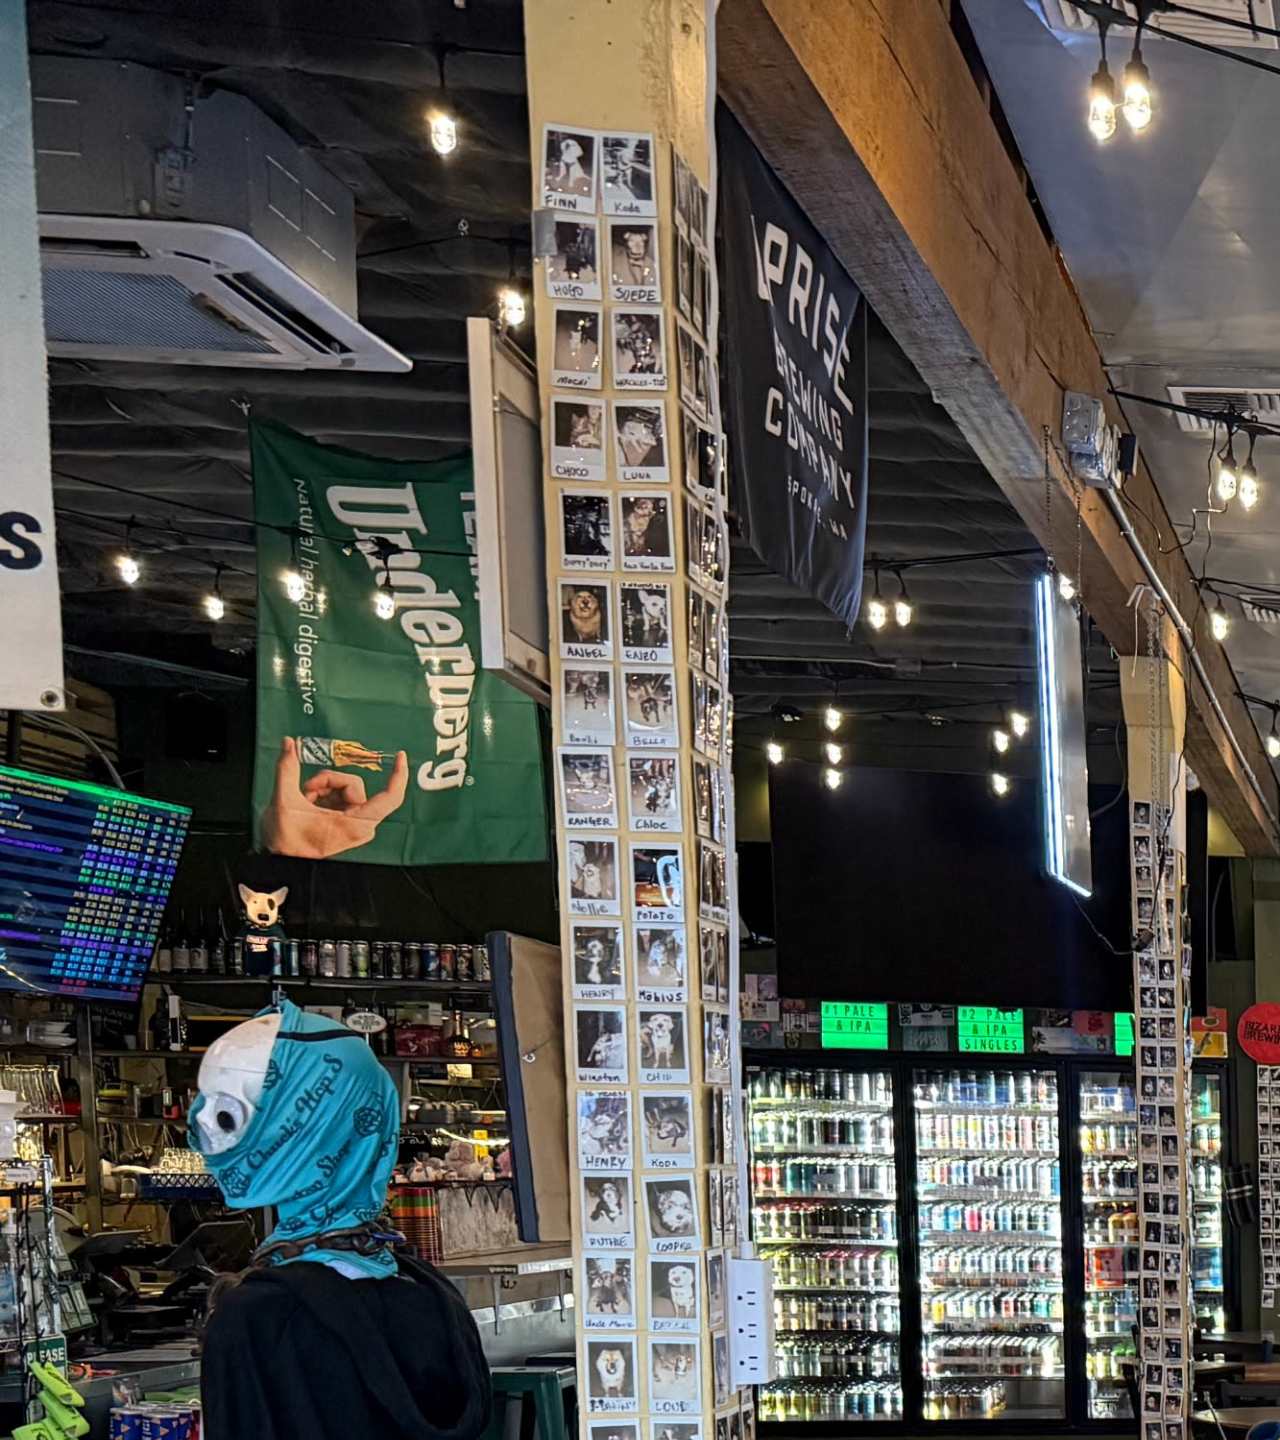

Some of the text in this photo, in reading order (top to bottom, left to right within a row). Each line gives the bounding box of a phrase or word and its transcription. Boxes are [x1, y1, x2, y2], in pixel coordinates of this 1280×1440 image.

[545, 194, 578, 210] FINN
[623, 471, 652, 481] LUNA
[325, 481, 477, 792] Underberg
[567, 646, 607, 658] ANGEL
[293, 624, 319, 715] digestive
[568, 816, 613, 827] RANGER
[581, 988, 616, 999] HENRY
[844, 1005, 875, 1017] PALE
[987, 1010, 1017, 1021] PALE
[850, 1021, 872, 1032] IPA
[986, 1025, 1008, 1036] IPA
[965, 1038, 1018, 1051] SINGLES
[585, 1156, 627, 1168] HENRY
